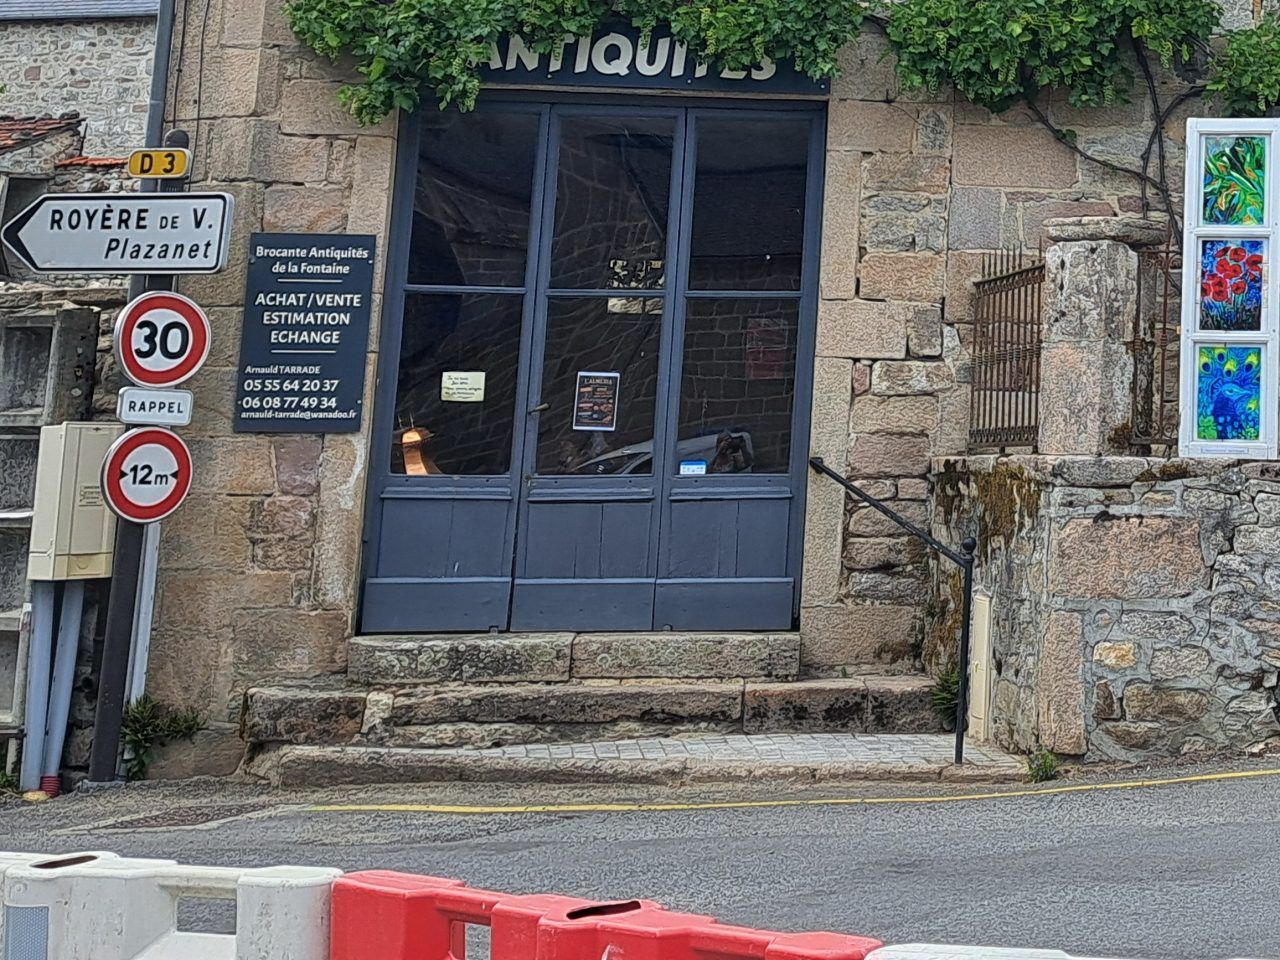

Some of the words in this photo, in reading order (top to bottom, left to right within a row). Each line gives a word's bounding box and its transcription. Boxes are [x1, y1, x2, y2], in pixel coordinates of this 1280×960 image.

[139, 153, 152, 174] D
[162, 153, 177, 174] 3
[50, 204, 149, 230] ROYÈRE
[159, 216, 180, 230] DE
[192, 208, 214, 230] V.
[104, 238, 213, 260] Plazanet
[256, 246, 307, 258] Brocante
[308, 246, 369, 261] Antiquités
[271, 262, 286, 273] de
[288, 262, 299, 273] la
[300, 262, 350, 274] Fontaine
[262, 311, 351, 325] ESTIMATION
[134, 320, 190, 360] 30
[270, 330, 341, 344] ECHANGE
[244, 365, 279, 374] Arnauld
[280, 366, 321, 374] TARRADE
[243, 380, 262, 391] 05
[263, 380, 281, 391] 55
[282, 380, 300, 391] 64
[301, 380, 320, 391] 20
[321, 380, 339, 391] 37
[128, 401, 184, 414] RAPPEL
[242, 397, 261, 408] 06
[262, 397, 281, 408] 08
[283, 397, 300, 408] 77
[300, 397, 318, 408] 49
[319, 397, 337, 408] 34
[241, 409, 357, 419] arnauld-tarrade@wanadoo.fr
[129, 464, 168, 486] 12m
